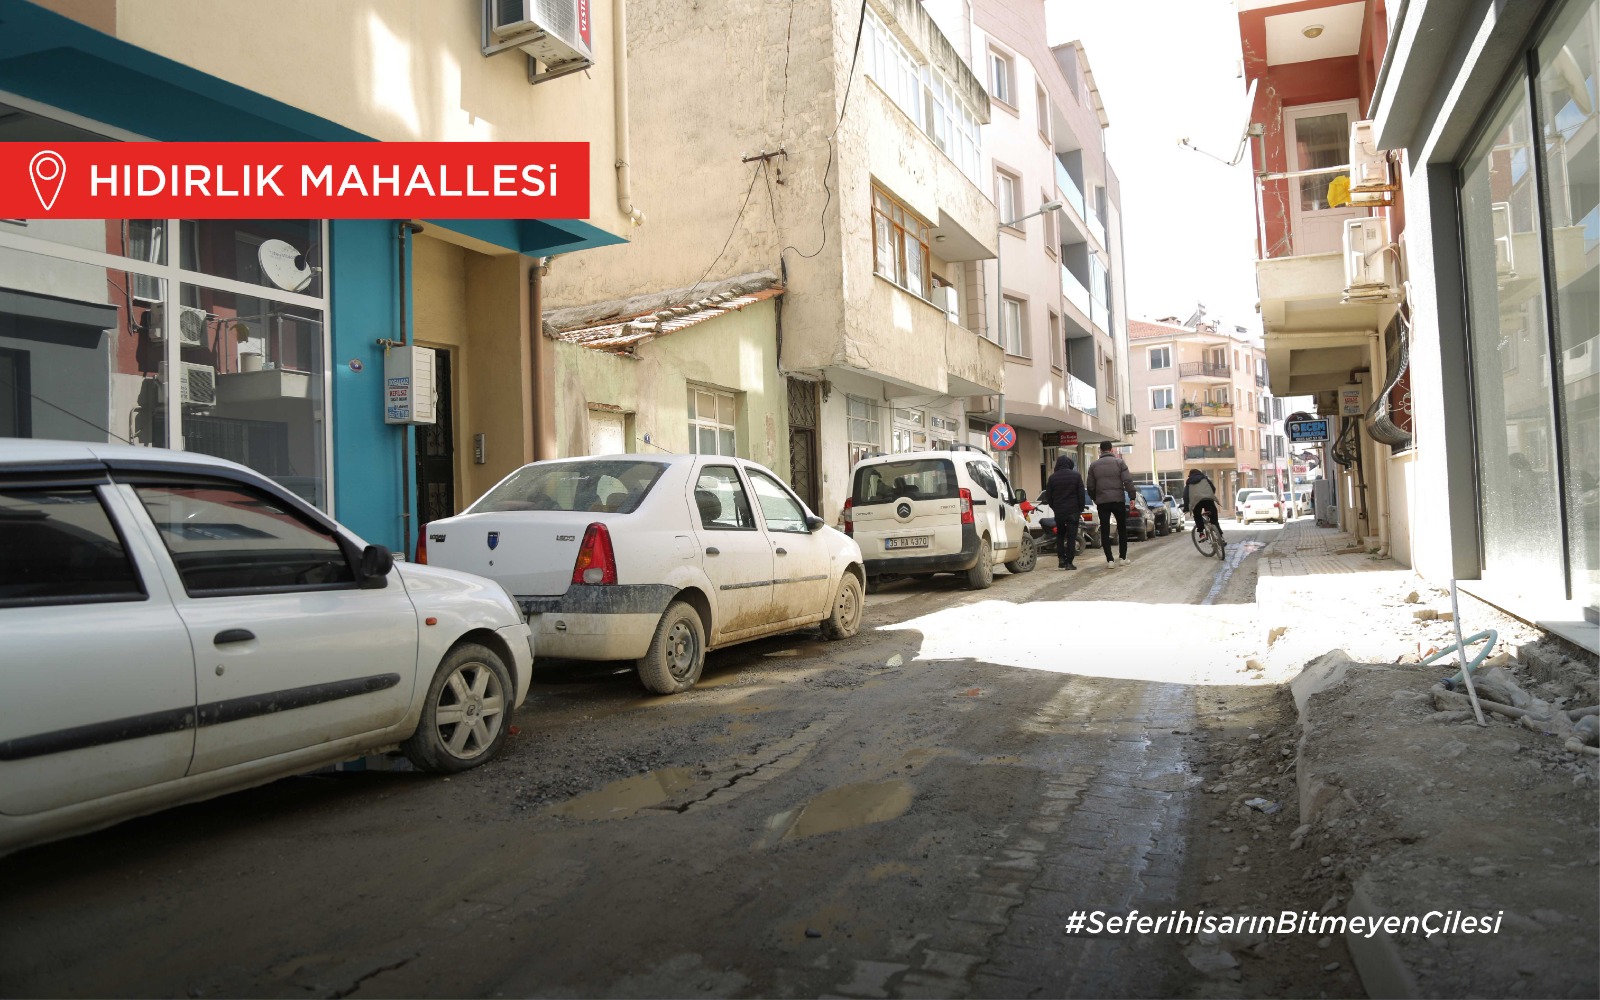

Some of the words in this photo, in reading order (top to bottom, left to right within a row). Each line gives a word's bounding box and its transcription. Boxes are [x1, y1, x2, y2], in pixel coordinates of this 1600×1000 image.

[889, 539, 898, 547] 35
[900, 538, 909, 546] HA
[911, 537, 927, 546] 4370
